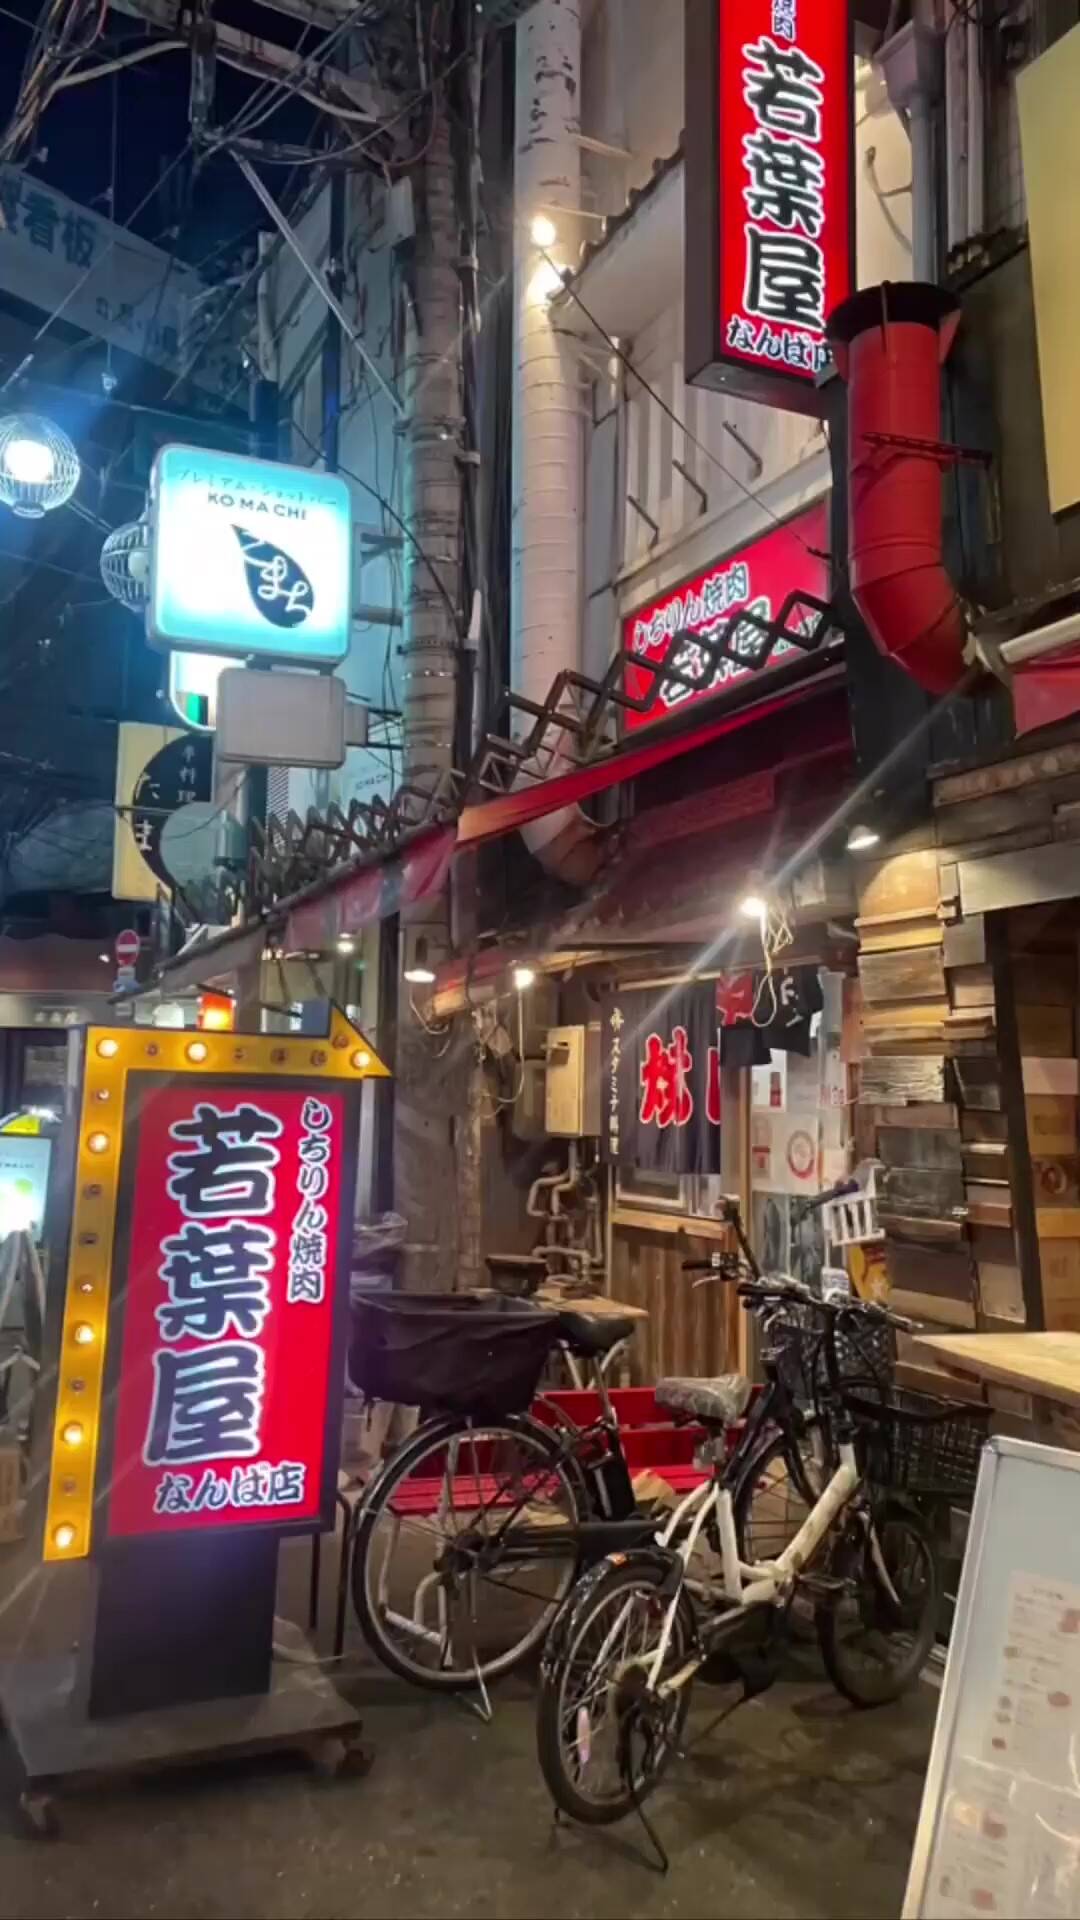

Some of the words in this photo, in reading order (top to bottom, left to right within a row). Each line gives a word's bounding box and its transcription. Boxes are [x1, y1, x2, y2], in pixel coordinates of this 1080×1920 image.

[741, 35, 826, 332] 若葉屋
[633, 561, 750, 656] しちりん焼肉
[639, 1025, 722, 1128] 焼
[286, 1096, 333, 1305] しちりん焼肉
[142, 1102, 284, 1467] 若葉屋
[153, 1460, 307, 1514] なんば店
